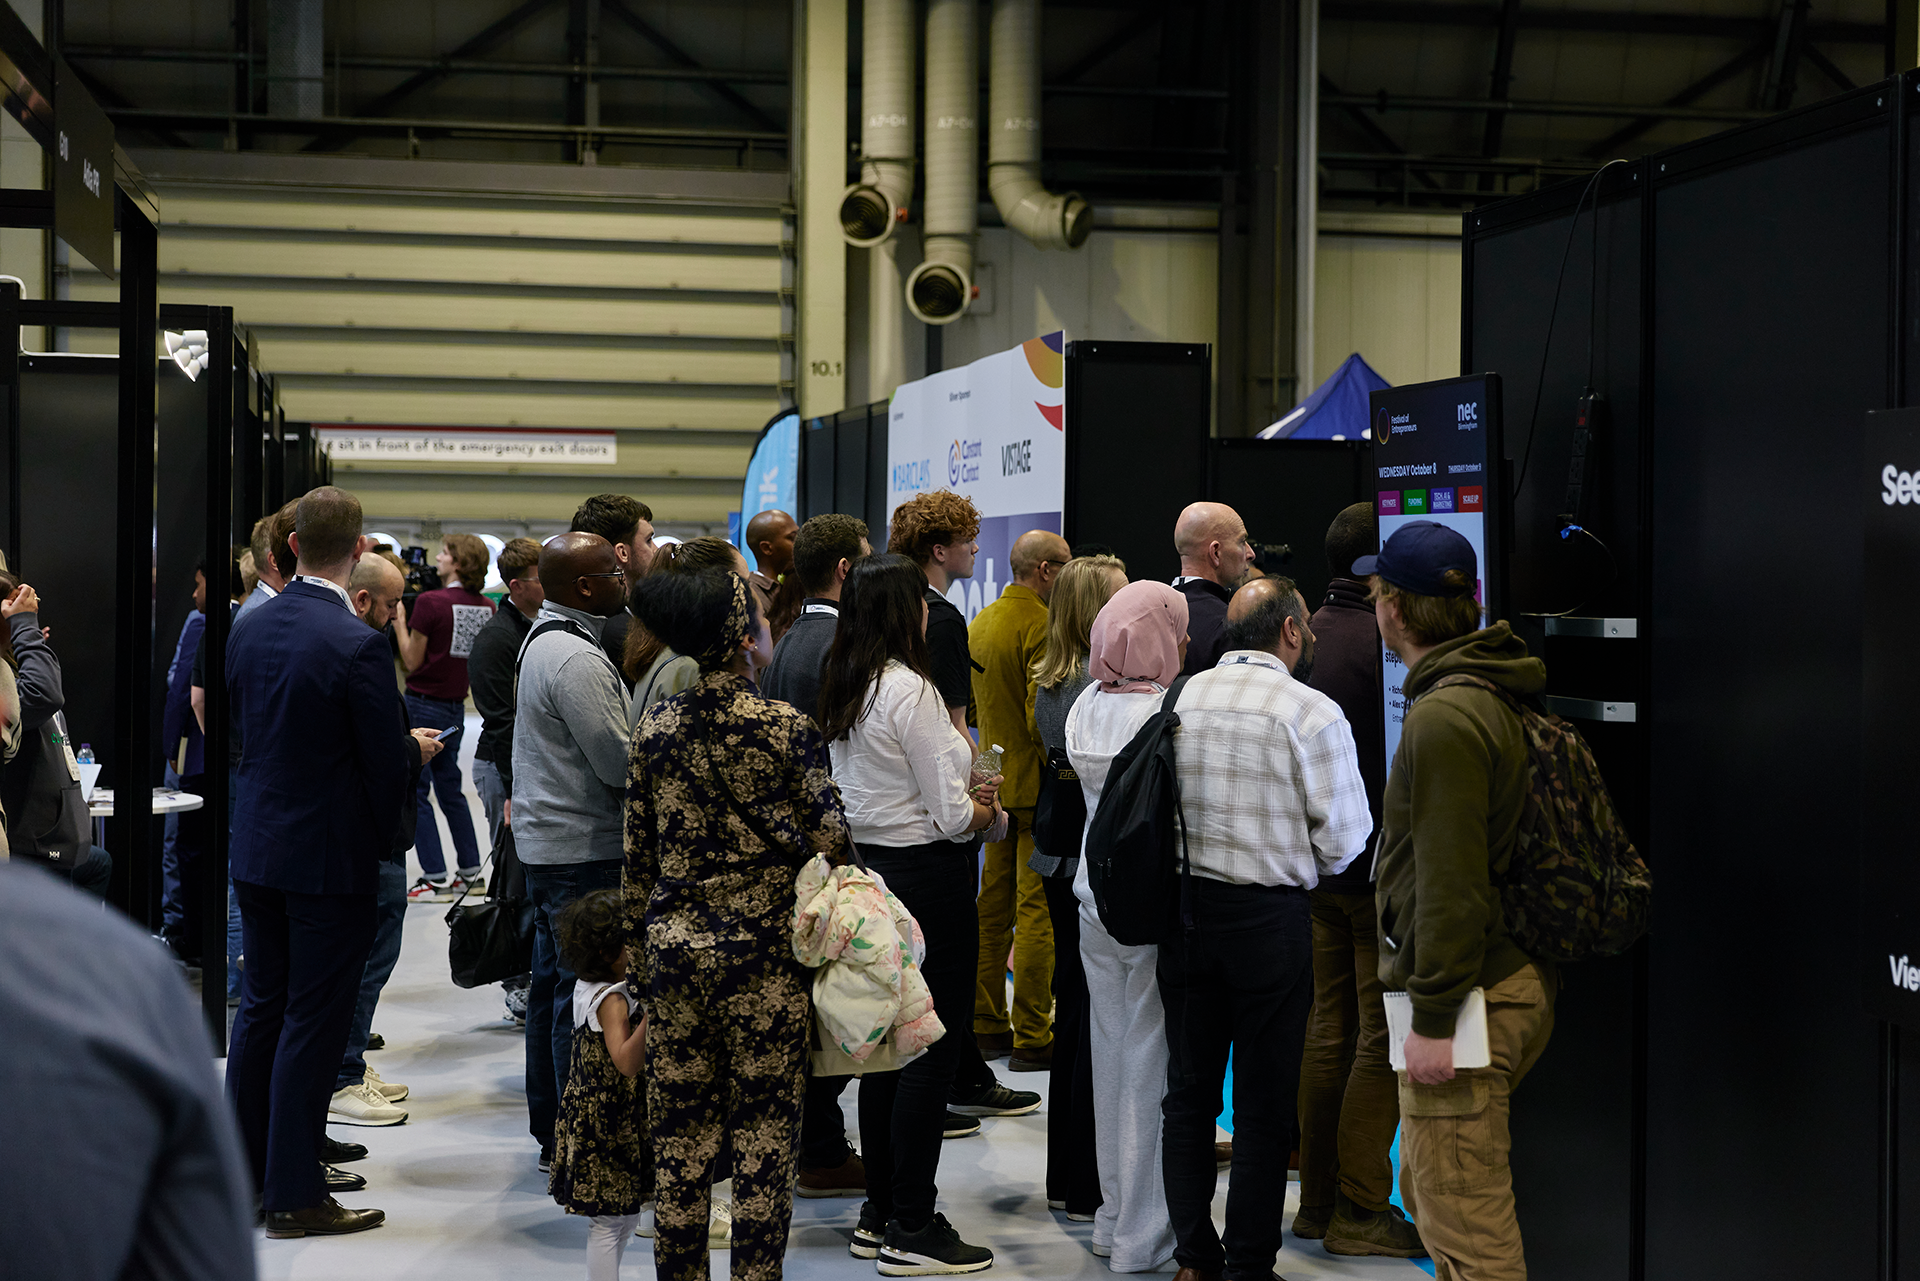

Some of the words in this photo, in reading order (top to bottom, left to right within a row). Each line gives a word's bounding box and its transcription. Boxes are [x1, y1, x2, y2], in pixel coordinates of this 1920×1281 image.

[811, 361, 842, 376] 10.1
[1457, 402, 1478, 421] nec
[1391, 424, 1417, 435] Entrepreneurs
[376, 437, 410, 452] front
[414, 438, 429, 452] of
[433, 438, 456, 453] the
[459, 442, 535, 457] emergency
[539, 440, 565, 455] exit
[569, 440, 609, 455] doors
[1001, 439, 1031, 477] VISTAGE
[897, 459, 930, 491] BARCLAYS
[1378, 464, 1410, 478] WEDNESDAY
[1410, 463, 1432, 476] October
[1432, 462, 1437, 474] 8
[1889, 954, 1920, 992] Vie
